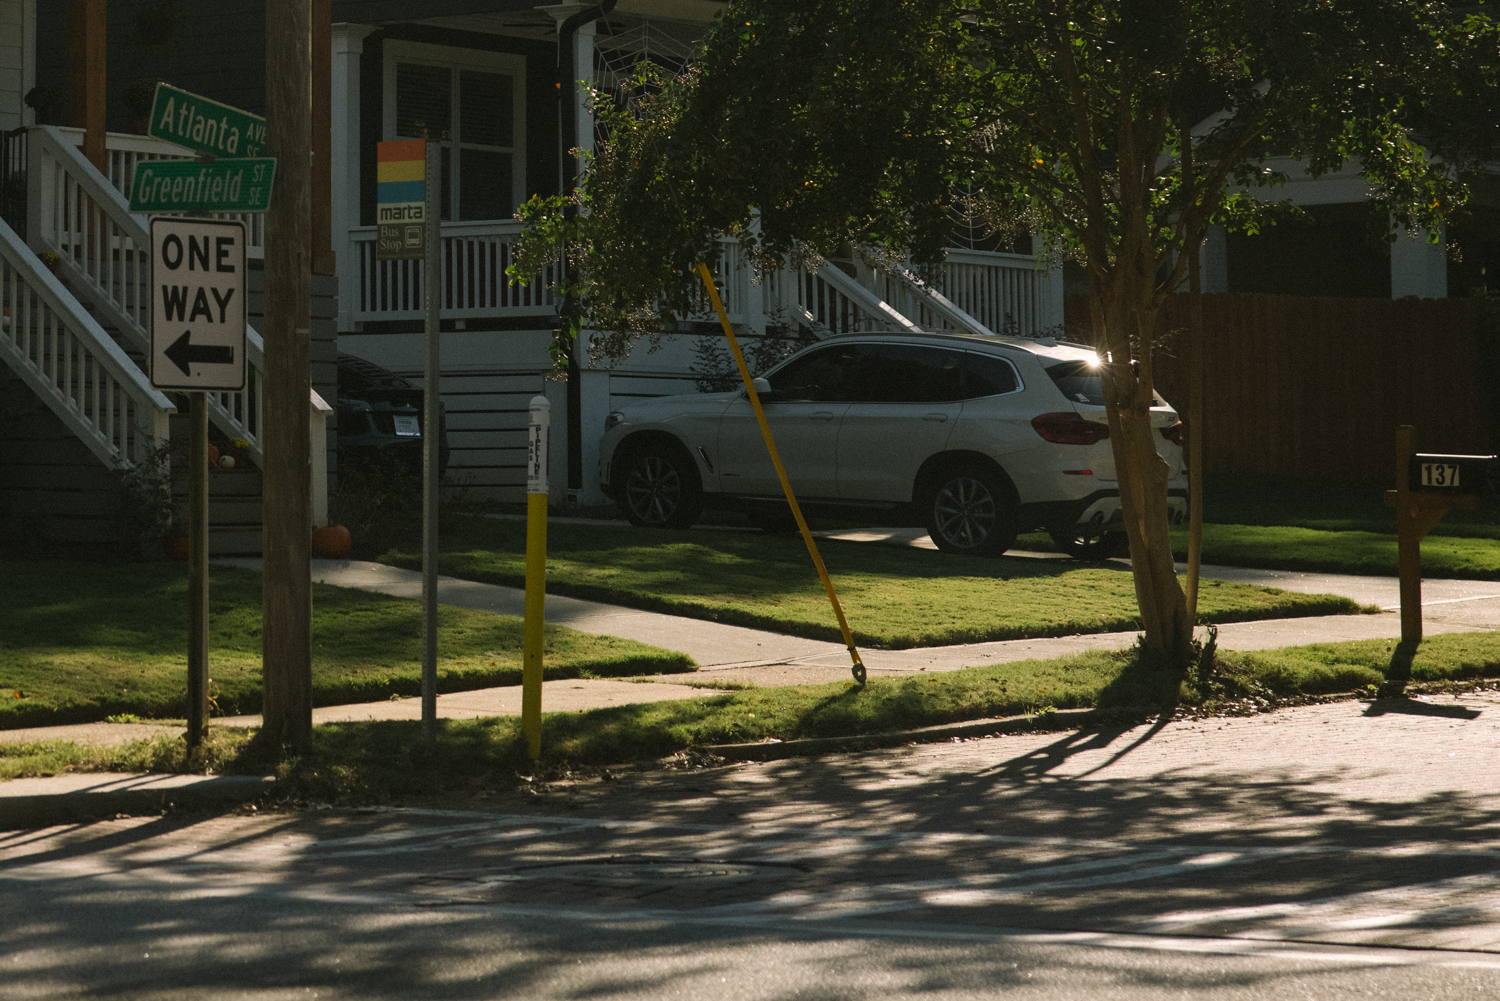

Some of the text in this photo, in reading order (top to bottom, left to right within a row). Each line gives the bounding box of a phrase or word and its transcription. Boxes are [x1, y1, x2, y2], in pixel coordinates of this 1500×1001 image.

[159, 96, 267, 154] Atlanta AVE
[138, 163, 266, 204] Greenfield ST
[248, 187, 262, 206] SE
[380, 205, 423, 221] marta
[380, 226, 399, 237] Bus
[161, 234, 236, 273] ONE
[380, 238, 402, 253] Stop
[161, 285, 236, 324] WAY
[1424, 464, 1457, 485] 137
